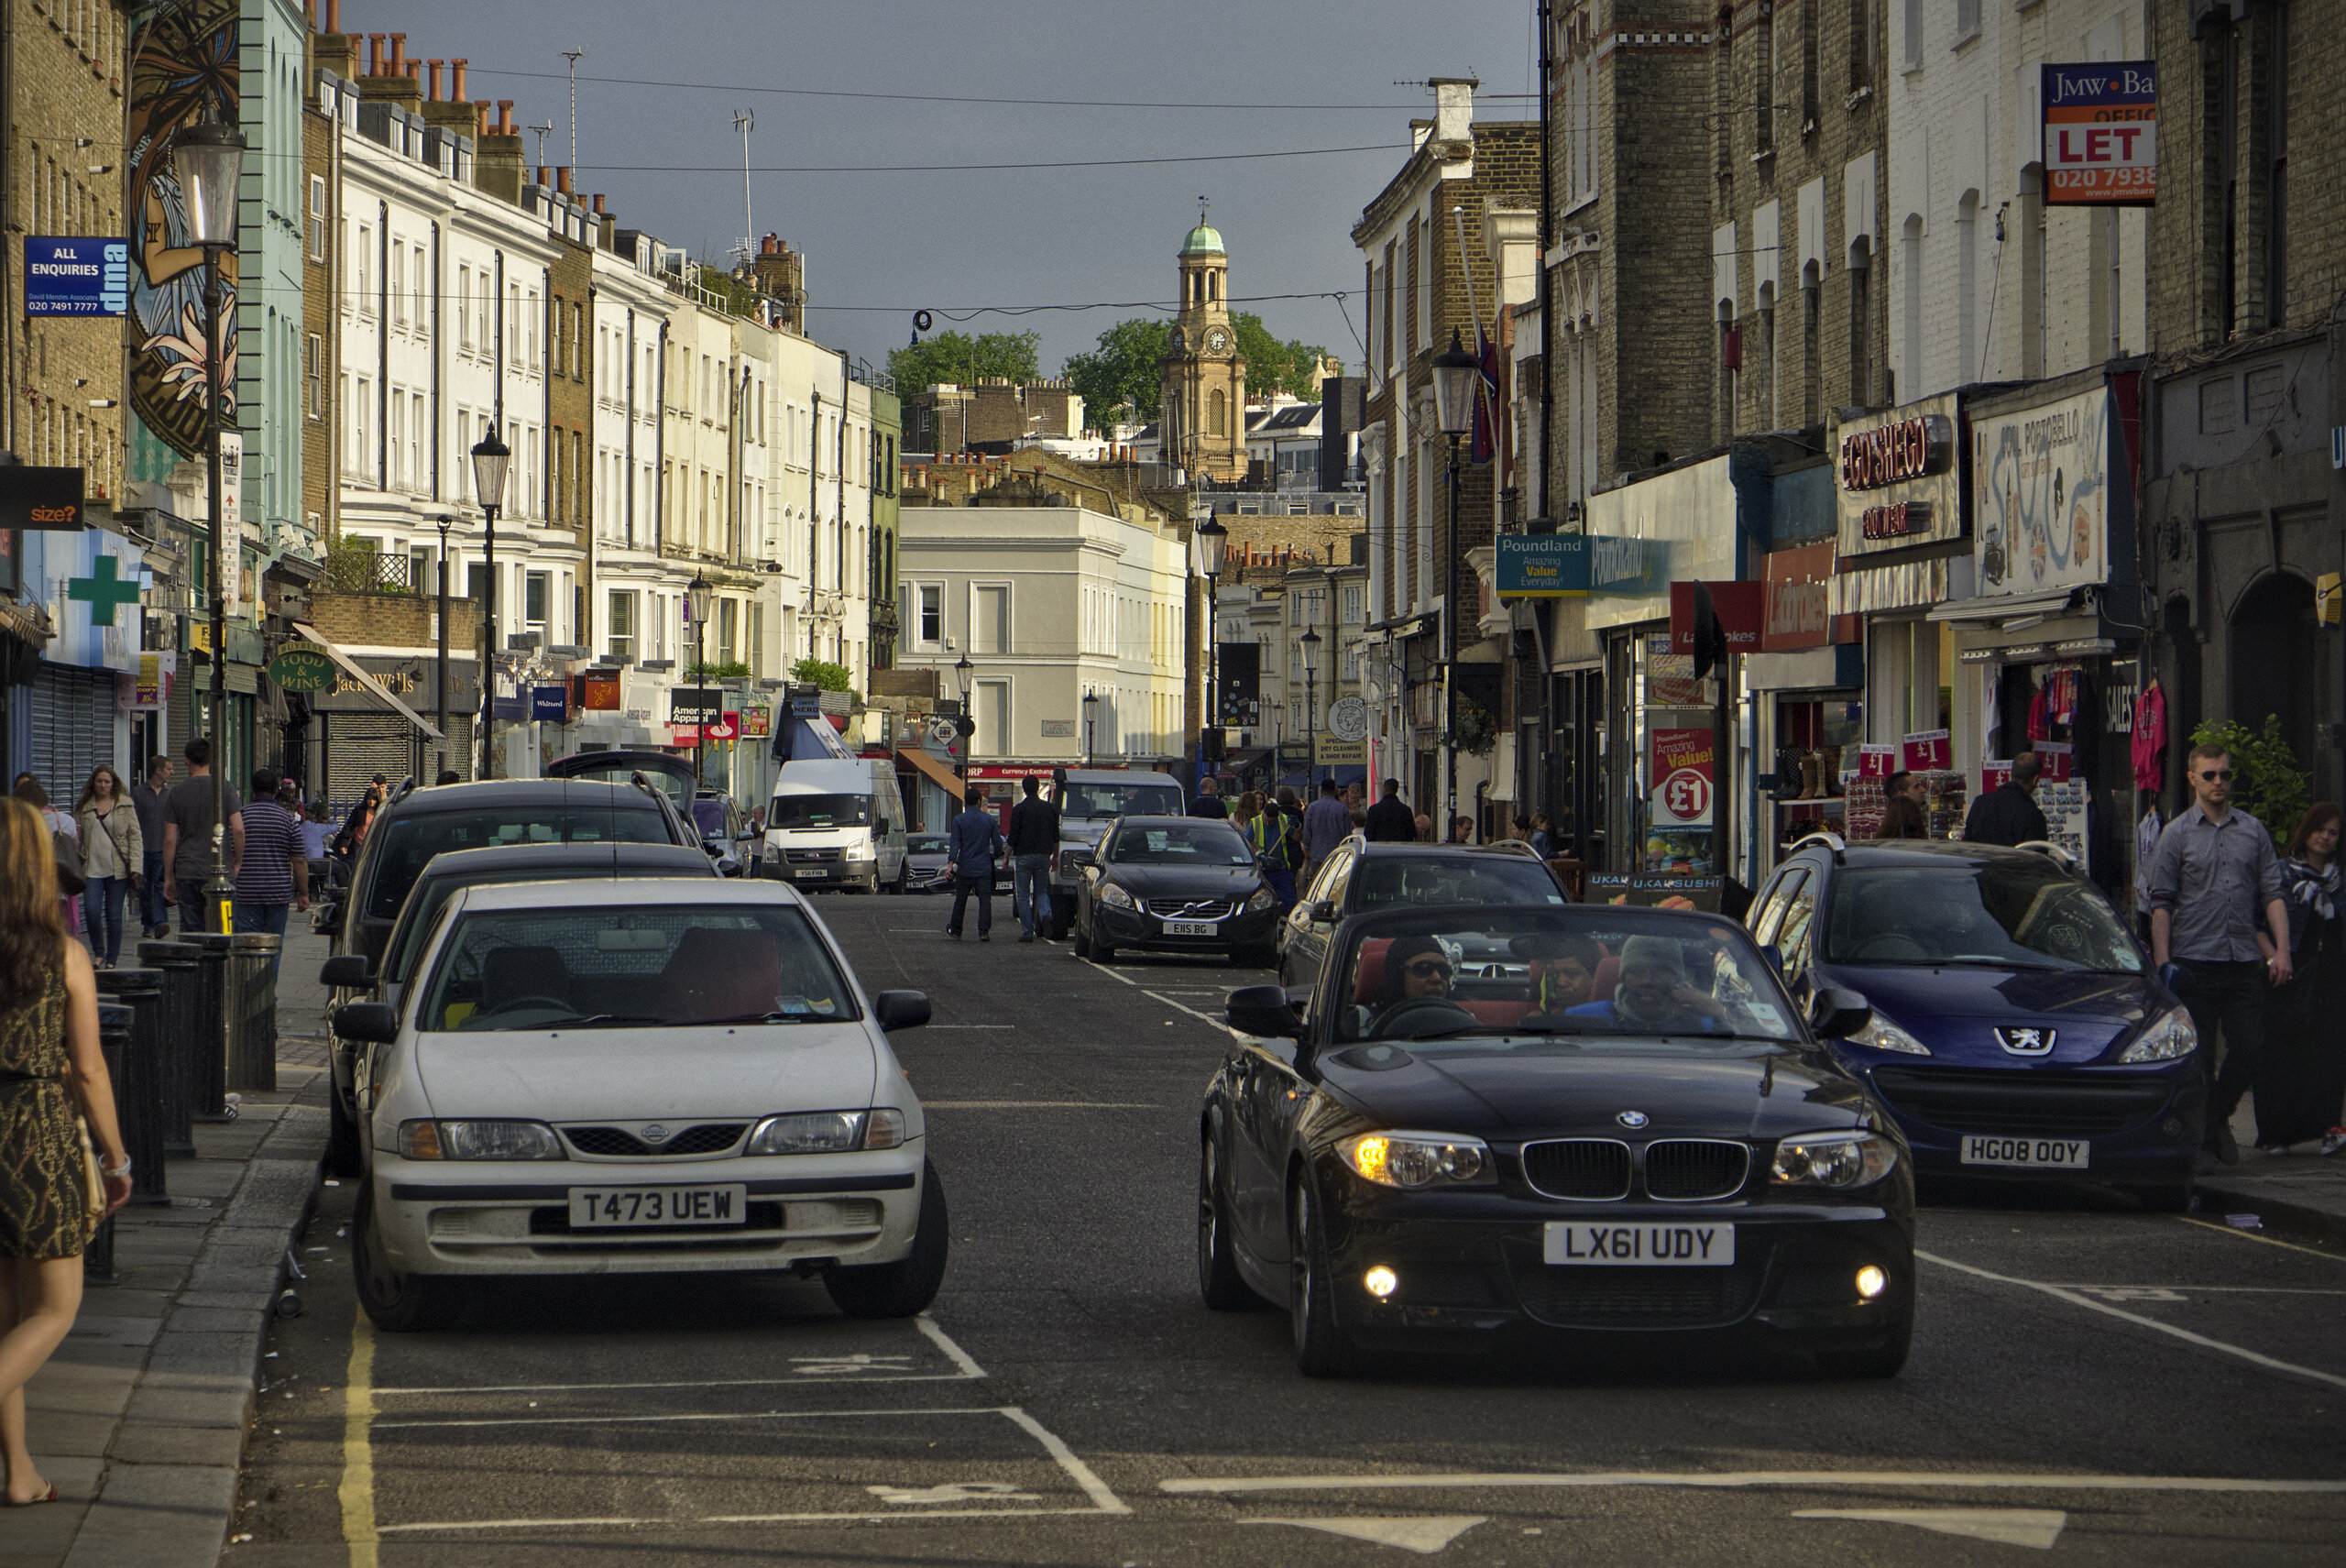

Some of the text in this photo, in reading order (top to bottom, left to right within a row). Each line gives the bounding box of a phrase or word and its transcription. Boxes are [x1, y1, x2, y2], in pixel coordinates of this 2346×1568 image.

[2053, 72, 2107, 103] JMW
[2059, 127, 2142, 163] LET
[2054, 167, 2155, 188] 020 7938
[54, 248, 77, 259] ALL
[32, 263, 99, 276] ENQUIRIES
[100, 244, 127, 312] dma
[28, 302, 98, 312] 020 7491 7777
[2024, 409, 2079, 456] PORTOBELLO
[1842, 416, 1926, 490] EGO SHEGO
[30, 505, 76, 522] size?
[1503, 539, 1582, 552] Poundland
[1592, 519, 1643, 587] Poundland
[1523, 556, 1561, 566] Amazing
[1526, 566, 1557, 576] Value
[1520, 576, 1563, 587] Everyday!
[1683, 631, 1756, 643] Laokes
[281, 642, 323, 652] BUYBEST
[280, 653, 324, 667] FOOD
[297, 665, 307, 676] &
[281, 674, 323, 689] WINE
[332, 673, 413, 696] Jack Wills
[673, 706, 718, 716] Amercan
[2107, 685, 2132, 733] SALES
[673, 714, 708, 723] Apparl
[1656, 732, 1690, 743] Poundland
[1657, 740, 1695, 756] Amazing
[1916, 740, 1939, 762] £1
[1667, 747, 1715, 768] Value!
[1869, 753, 1885, 775] £1
[2045, 751, 2060, 777] £1
[1002, 768, 1028, 776] Currency
[1029, 767, 1055, 776] Exchang
[1671, 780, 1703, 812] £1
[1675, 879, 1719, 888] SUSHI
[1194, 925, 1207, 934] BG
[1971, 1139, 2030, 1161] HG08
[584, 1190, 731, 1222] T473 UEW
[1566, 1228, 1716, 1258] LX61 UDY
